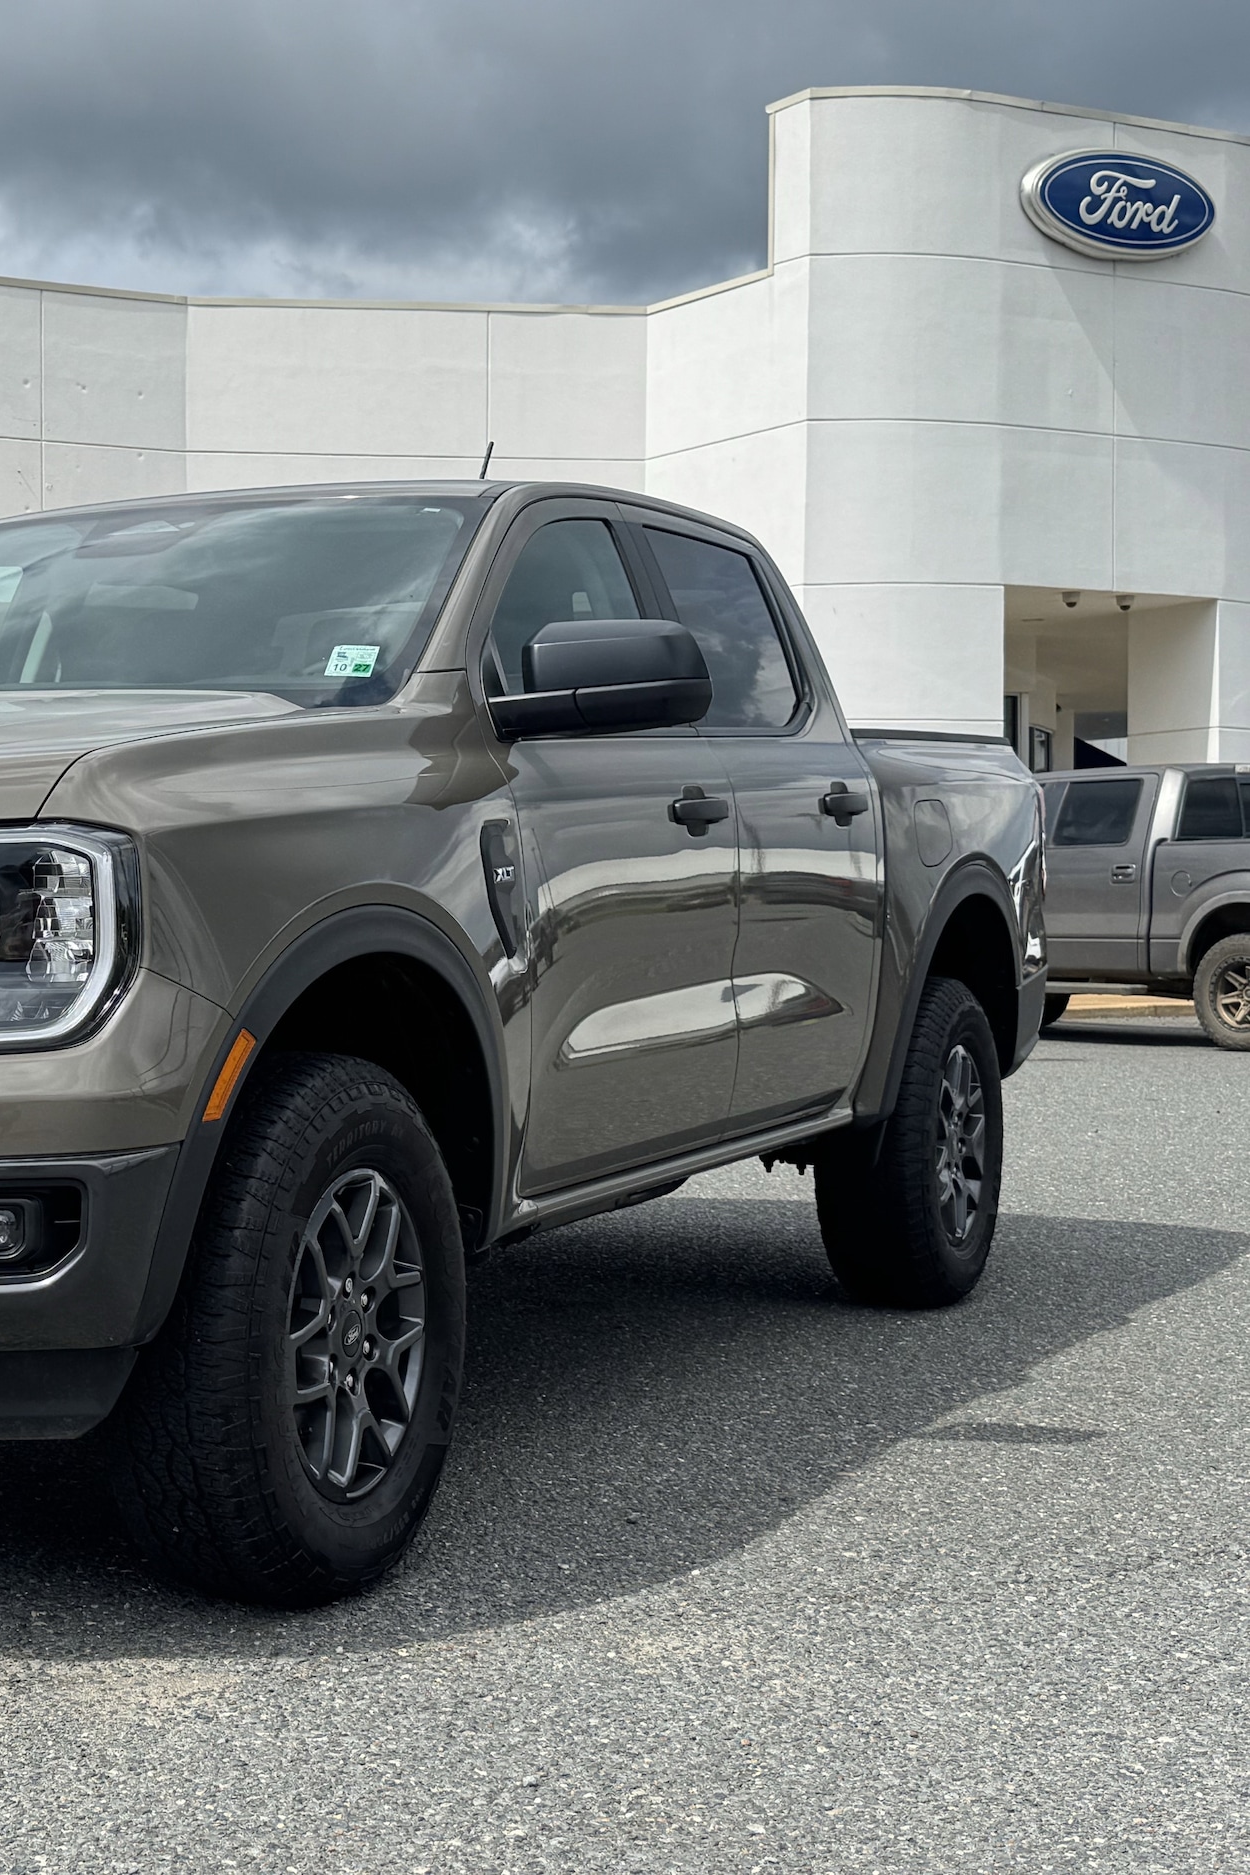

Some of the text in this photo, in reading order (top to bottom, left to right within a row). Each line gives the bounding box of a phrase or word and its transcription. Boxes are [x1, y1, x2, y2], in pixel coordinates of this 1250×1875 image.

[1079, 169, 1181, 234] Ford
[333, 663, 370, 672] 10 27
[493, 866, 515, 884] XLT
